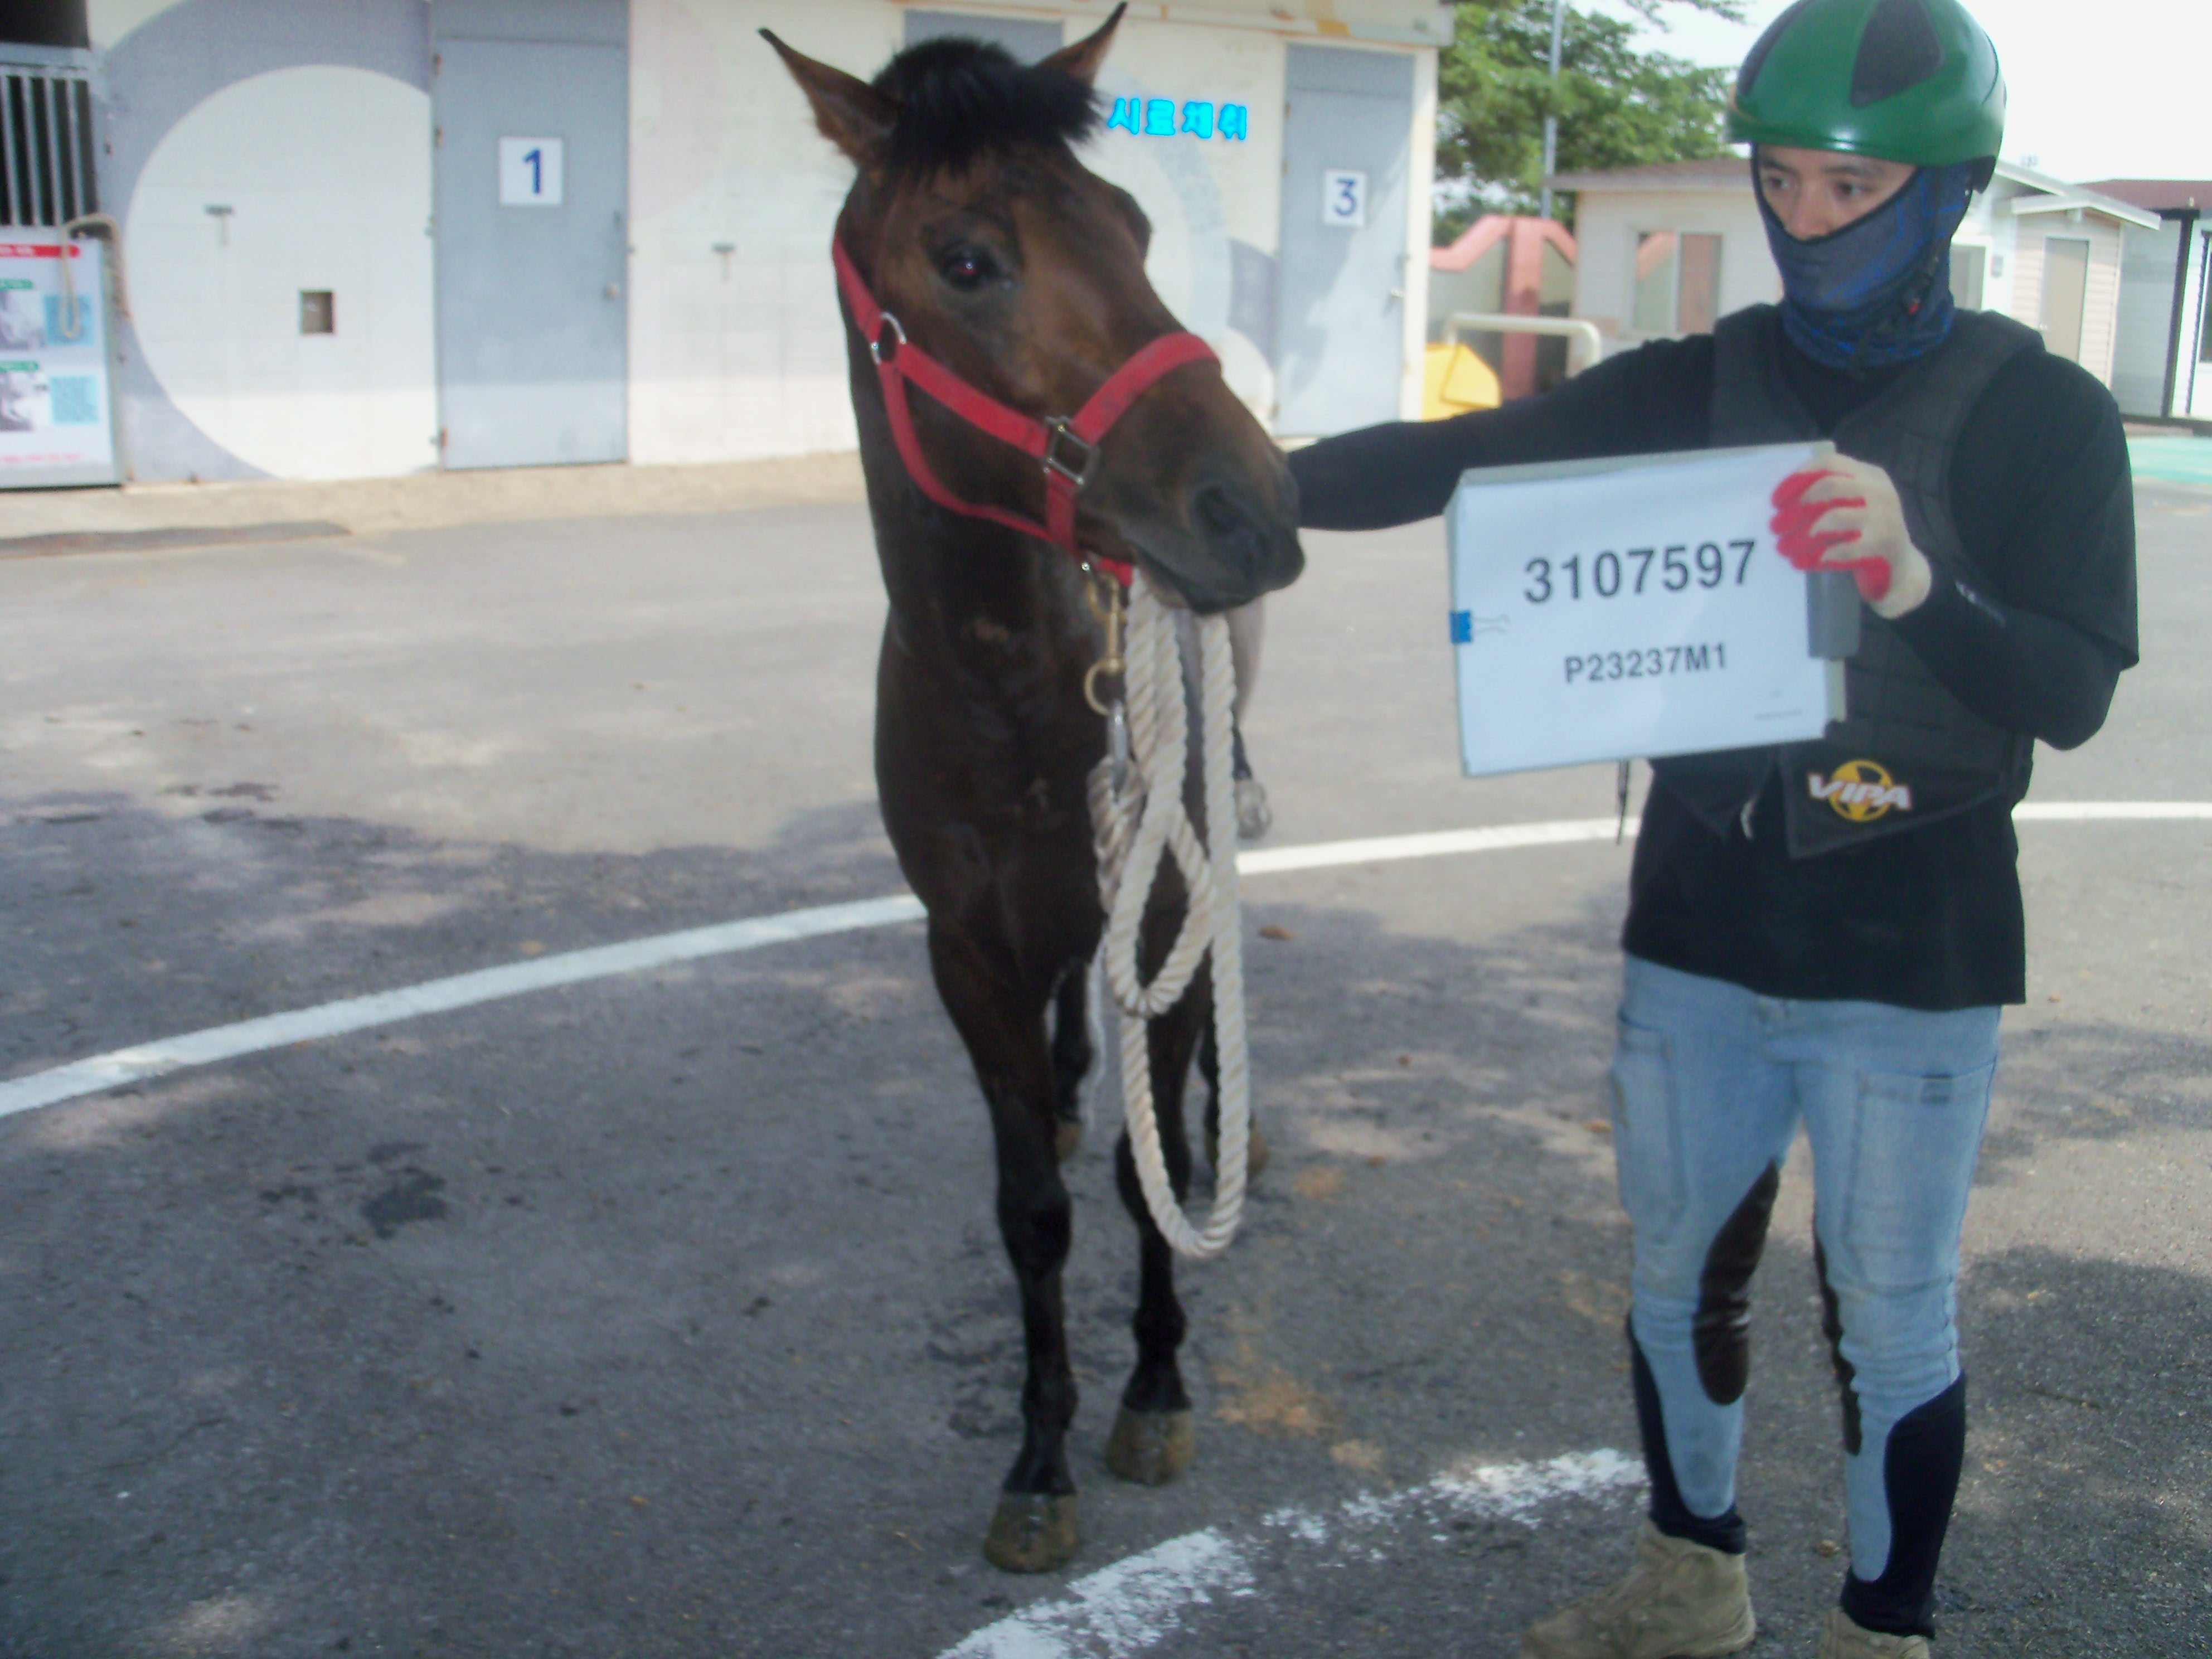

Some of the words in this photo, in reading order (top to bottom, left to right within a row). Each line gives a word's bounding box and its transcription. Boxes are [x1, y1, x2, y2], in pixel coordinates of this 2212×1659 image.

[523, 148, 541, 194] 1
[1334, 178, 1357, 216] 3
[1525, 539, 1756, 604] 3107597
[1565, 643, 1727, 683] P23237M1
[1808, 773, 1912, 810] VIPA
